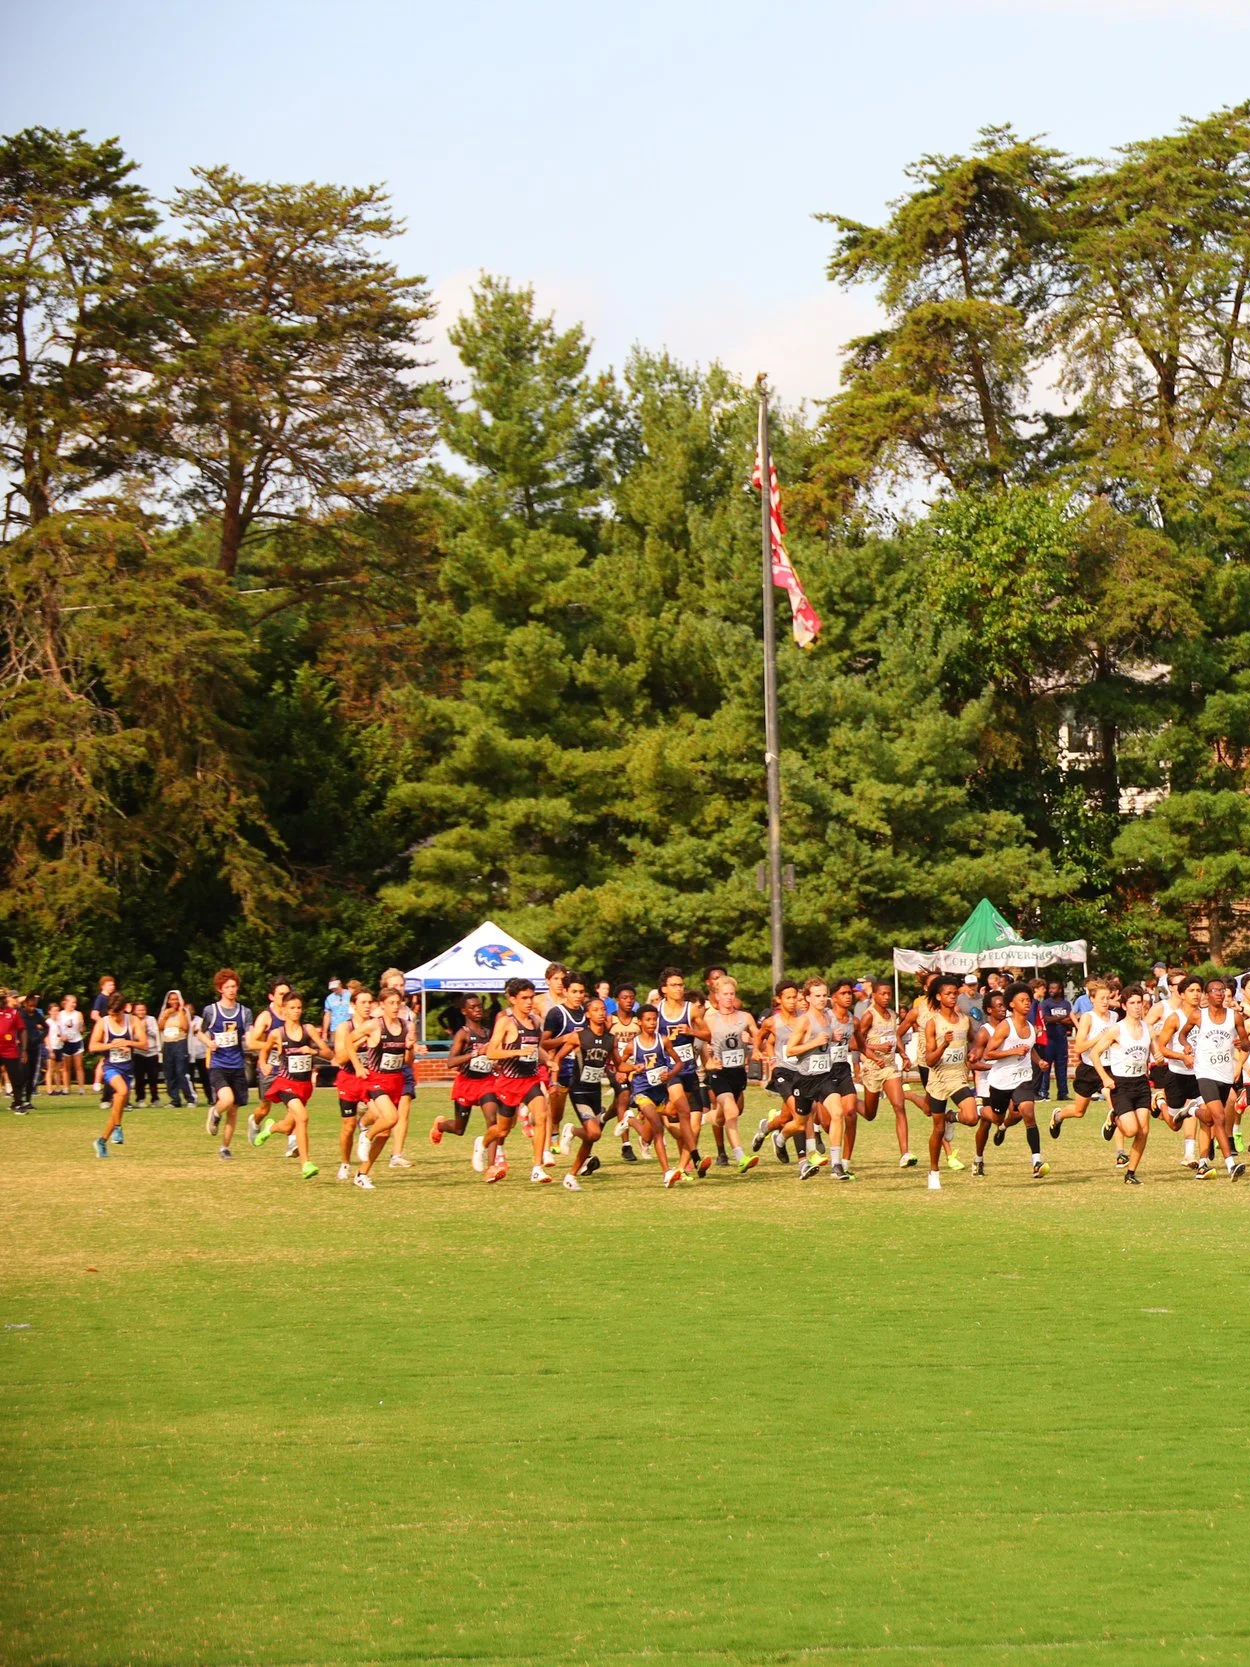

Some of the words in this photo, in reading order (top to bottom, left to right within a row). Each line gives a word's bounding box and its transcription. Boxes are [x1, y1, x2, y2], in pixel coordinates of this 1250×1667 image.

[218, 1037, 236, 1046] 234
[725, 1055, 744, 1065] 747
[946, 1053, 963, 1062] 780
[1210, 1053, 1230, 1064] 696
[292, 1060, 310, 1070] 435
[473, 1061, 491, 1071] 420
[812, 1060, 829, 1069] 761
[1124, 1064, 1142, 1074] 714
